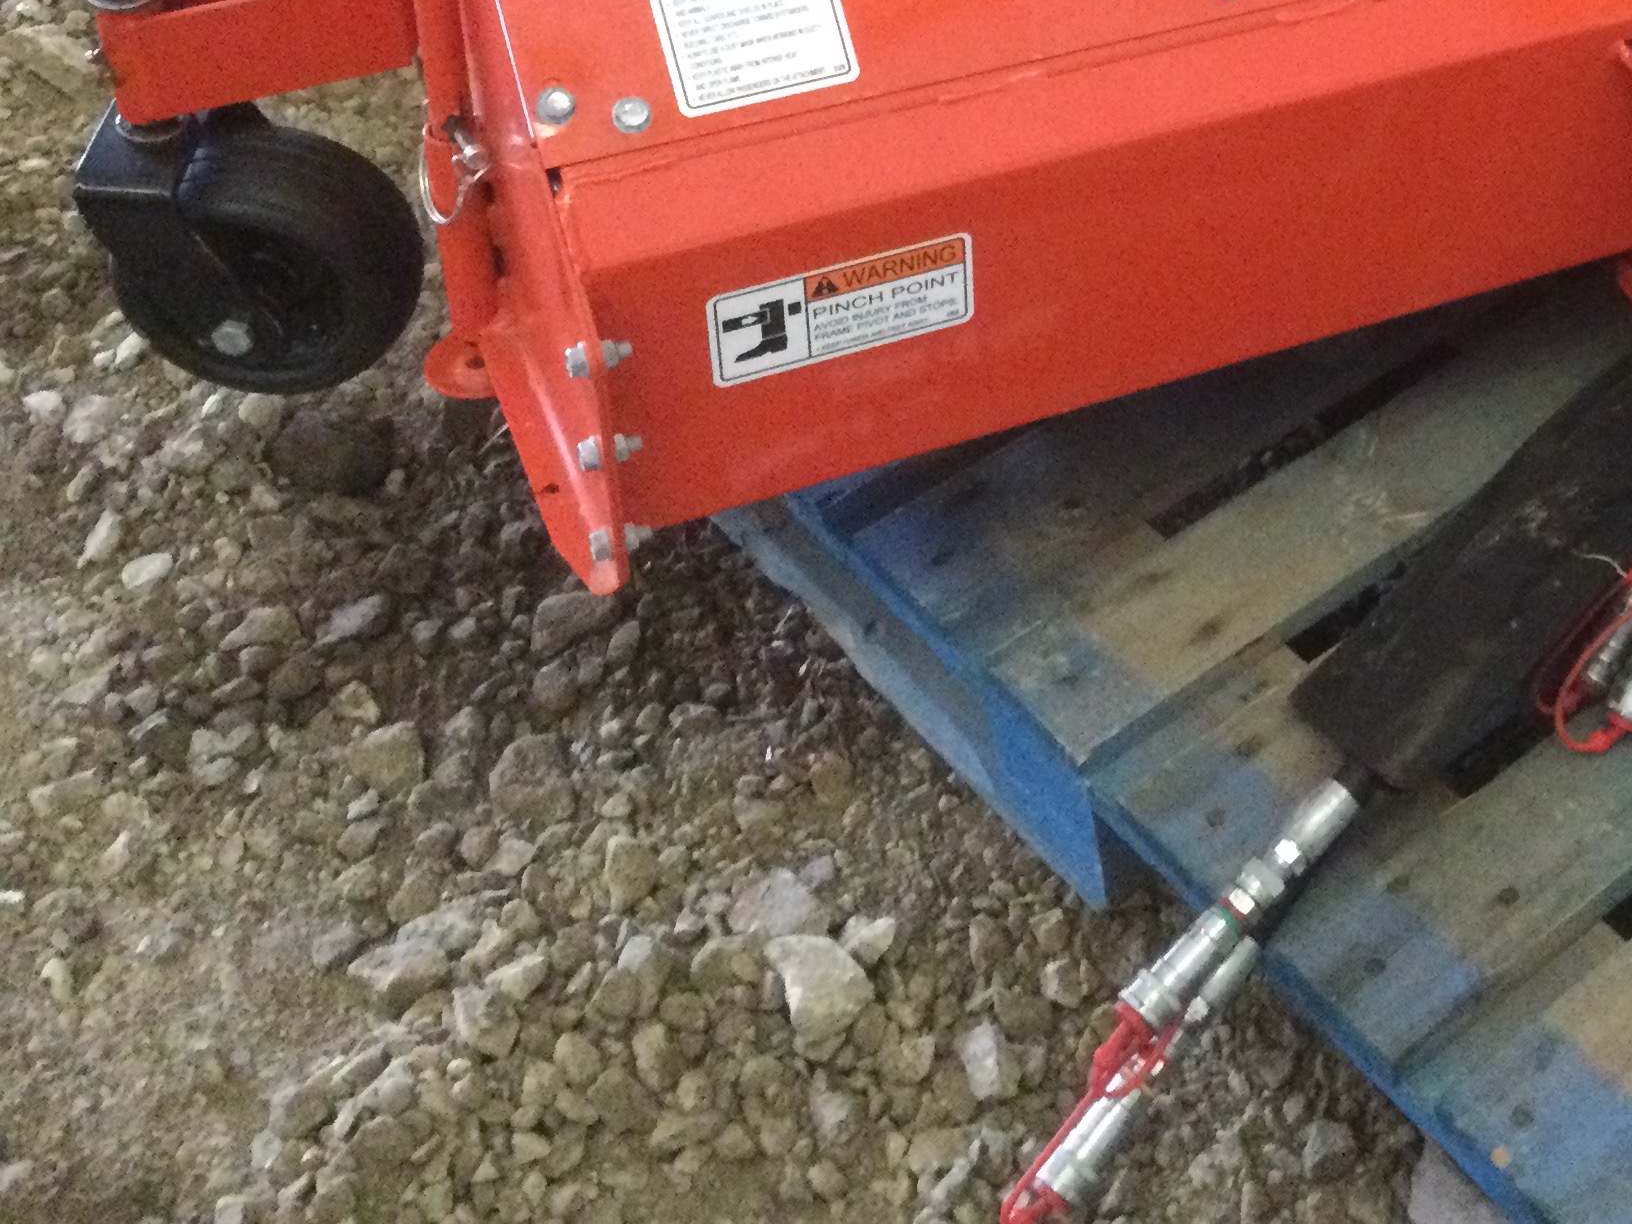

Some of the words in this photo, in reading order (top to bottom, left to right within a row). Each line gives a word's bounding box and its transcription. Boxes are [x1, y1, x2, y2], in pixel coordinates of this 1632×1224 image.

[842, 244, 957, 287] WARNING
[813, 291, 884, 320] PINCH
[891, 271, 959, 299] POINT
[814, 317, 849, 332] AVOID
[894, 295, 928, 310] FROM
[815, 328, 851, 342] FRAME
[856, 316, 889, 331] PIVOT
[893, 308, 917, 322] AND
